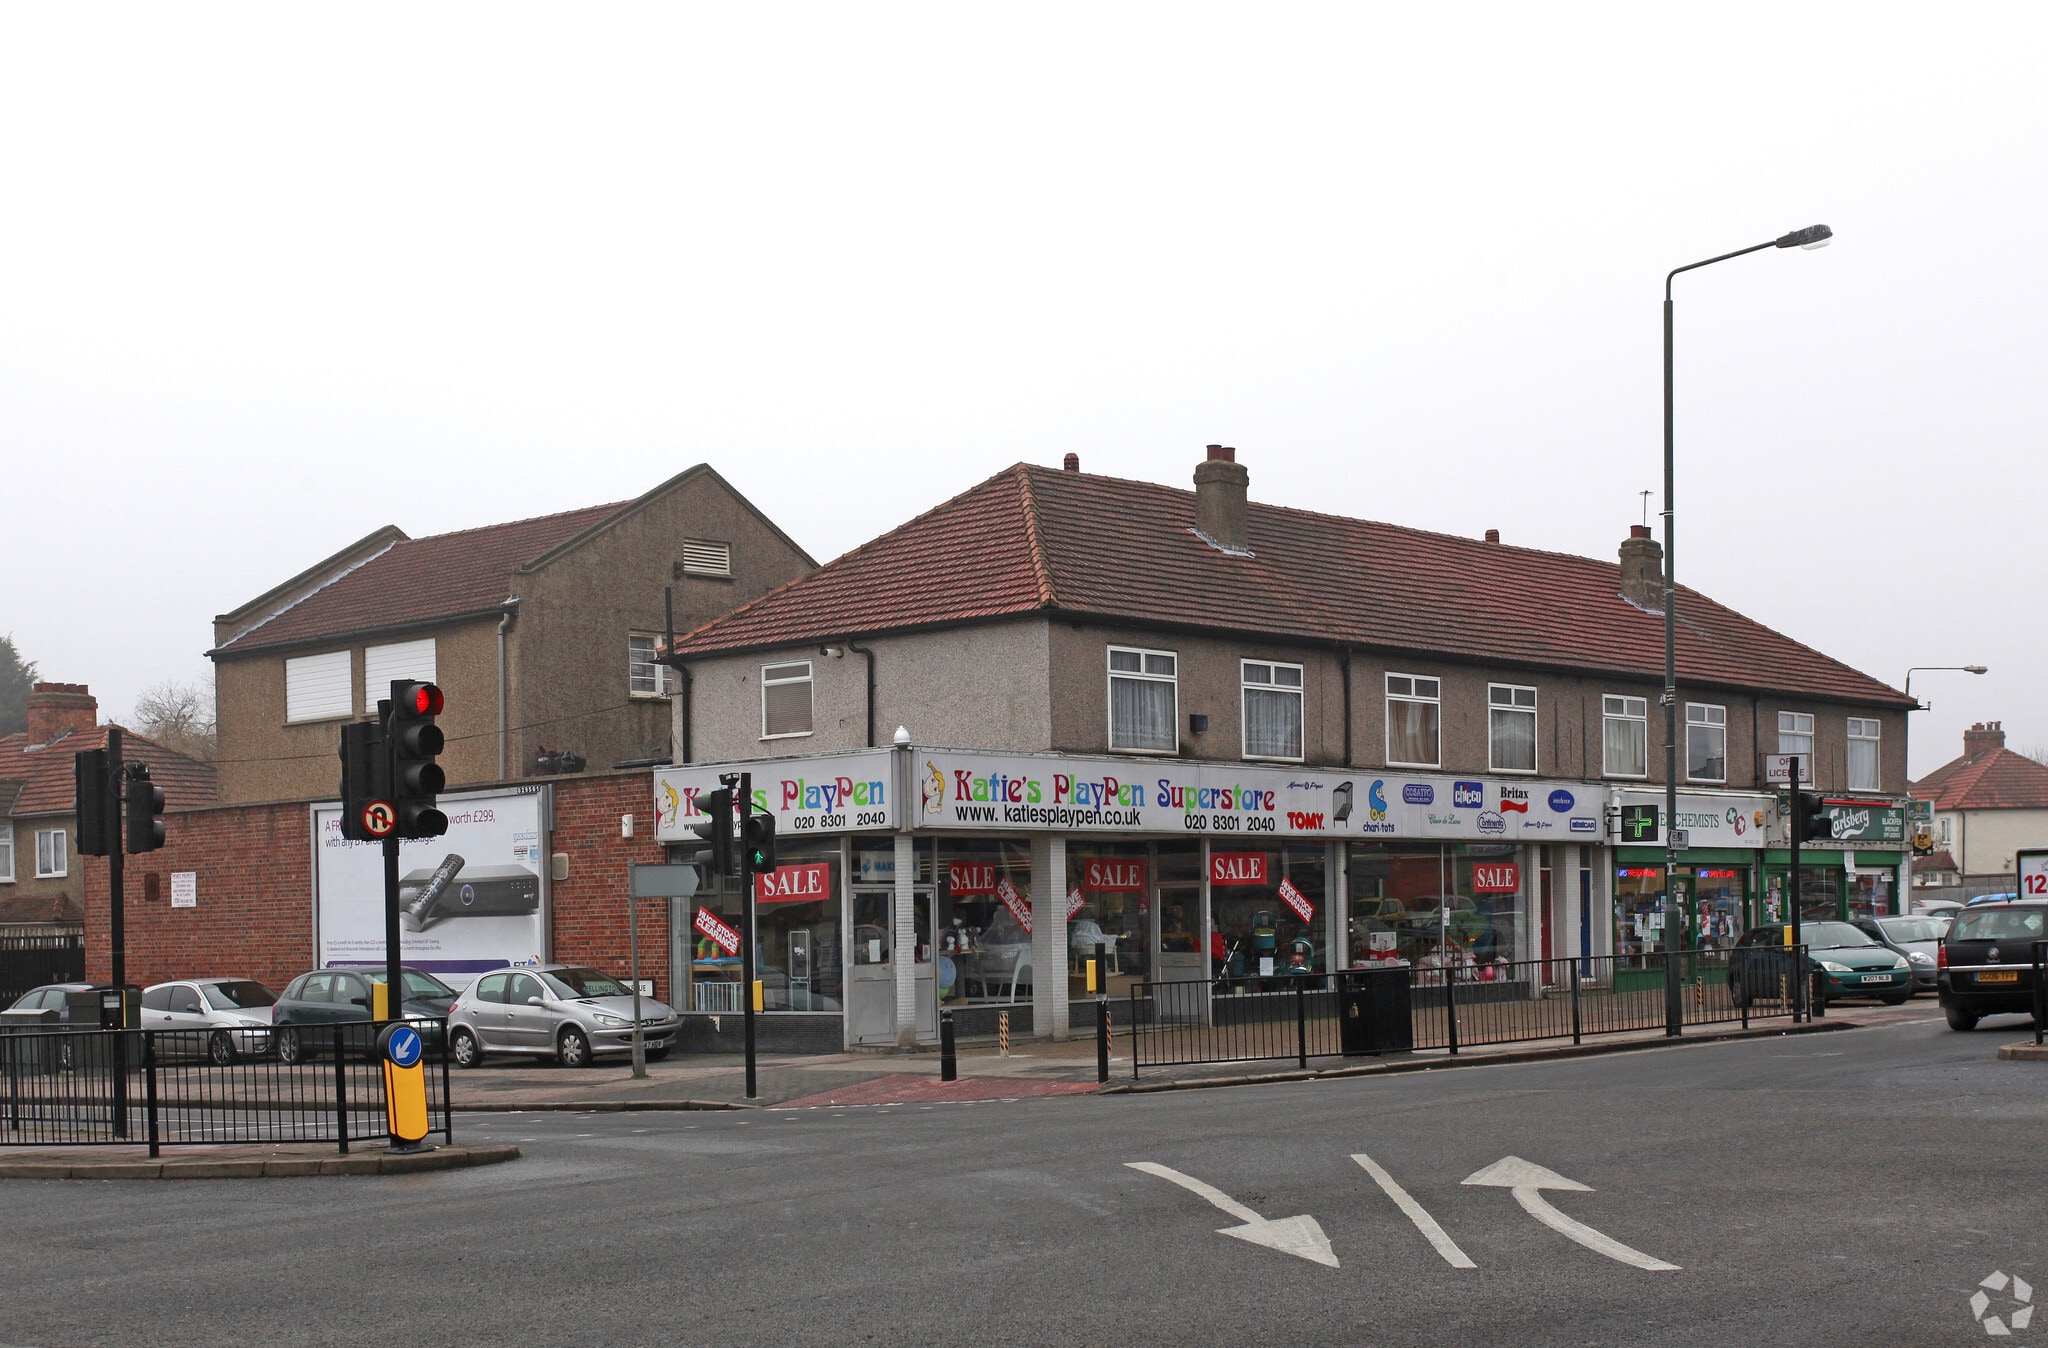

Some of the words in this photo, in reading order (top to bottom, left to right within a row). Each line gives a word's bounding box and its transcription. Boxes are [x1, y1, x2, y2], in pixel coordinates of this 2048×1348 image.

[1779, 757, 1791, 765] OF
[1769, 769, 1805, 777] LICEE
[780, 776, 885, 814] PlayPen
[953, 769, 1042, 801] Katie's
[1052, 774, 1145, 811] PlayPen
[1157, 778, 1275, 811] Superstore
[1405, 787, 1431, 797] COSATTO
[1455, 785, 1482, 804] chicco
[1500, 786, 1529, 799] Britax
[325, 821, 331, 832] A
[332, 820, 341, 832] FR
[449, 811, 472, 824] worth
[473, 809, 496, 823] £299,
[794, 816, 815, 829] 020
[820, 814, 846, 828] 8301
[856, 811, 885, 826] 2040
[1004, 804, 1141, 827] katiesplaypen.co.uk
[1184, 814, 1207, 830] 020
[1213, 815, 1240, 831] 8301
[1247, 817, 1275, 831] 2040
[1675, 813, 1720, 828] CHEMISTS
[1829, 807, 1869, 839] Carlsberg
[326, 835, 341, 848] with
[342, 839, 353, 849] any
[950, 867, 994, 890] SALE
[1090, 863, 1140, 886] SALE
[1215, 857, 1261, 880] SALE
[1477, 868, 1514, 888] SALE
[763, 869, 822, 897] SALE
[1000, 878, 1018, 902] HUGE
[2024, 874, 2047, 894] 12
[997, 885, 1032, 932] CLEARANCE
[1279, 886, 1312, 922] CLEARANCE
[1281, 879, 1297, 897] HUGE
[1295, 894, 1313, 915] STOCK
[696, 917, 737, 953] CLEARANCE
[698, 909, 717, 928] HUGE
[716, 924, 739, 945] STOCK
